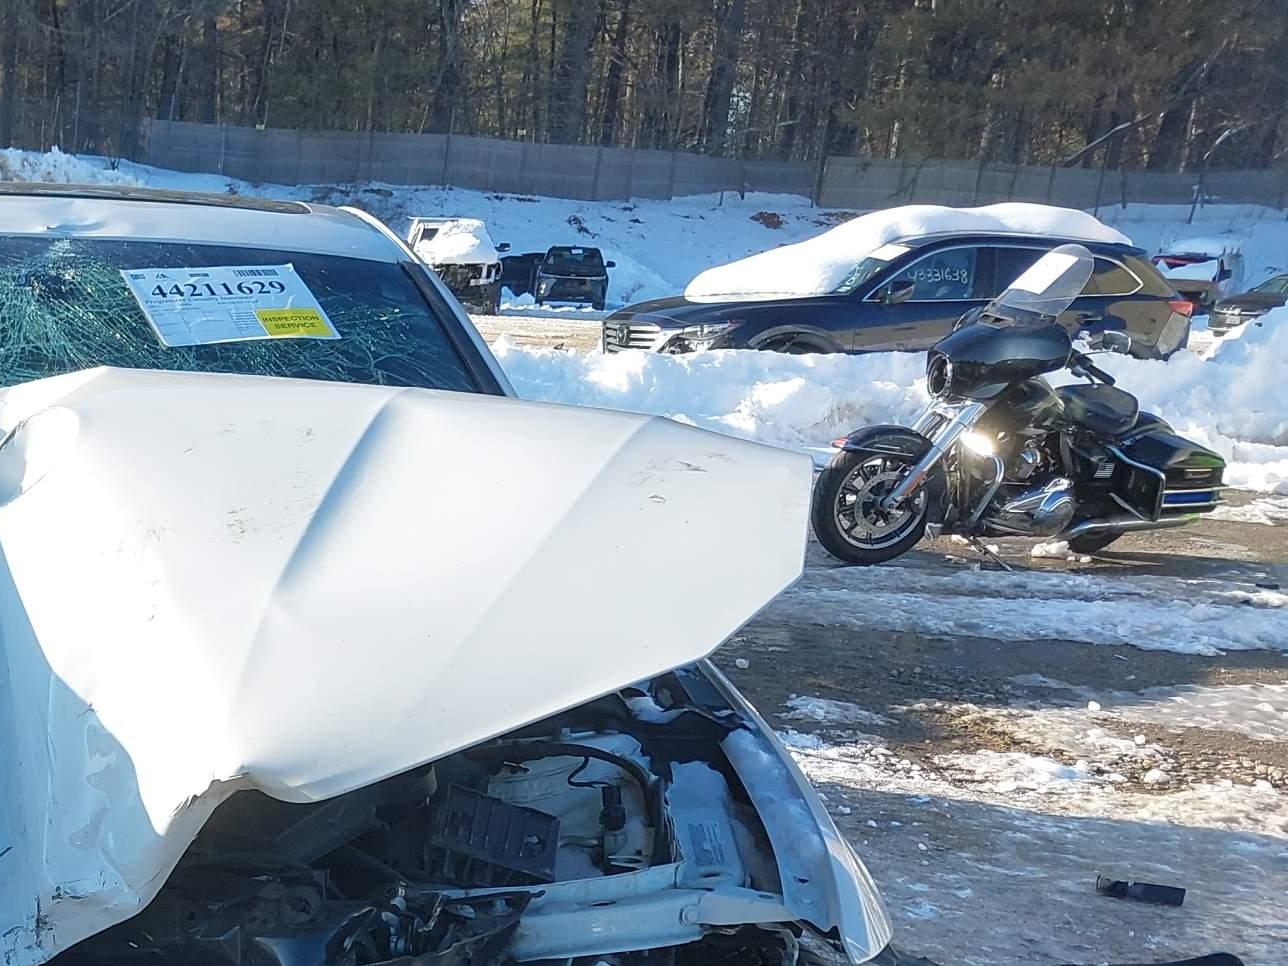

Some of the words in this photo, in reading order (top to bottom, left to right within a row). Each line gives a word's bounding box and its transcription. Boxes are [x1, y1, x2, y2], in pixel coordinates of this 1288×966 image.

[907, 268, 968, 284] 43331638
[152, 281, 286, 298] 44211629
[261, 315, 320, 323] INSPECTION
[273, 321, 319, 329] SERVICE
